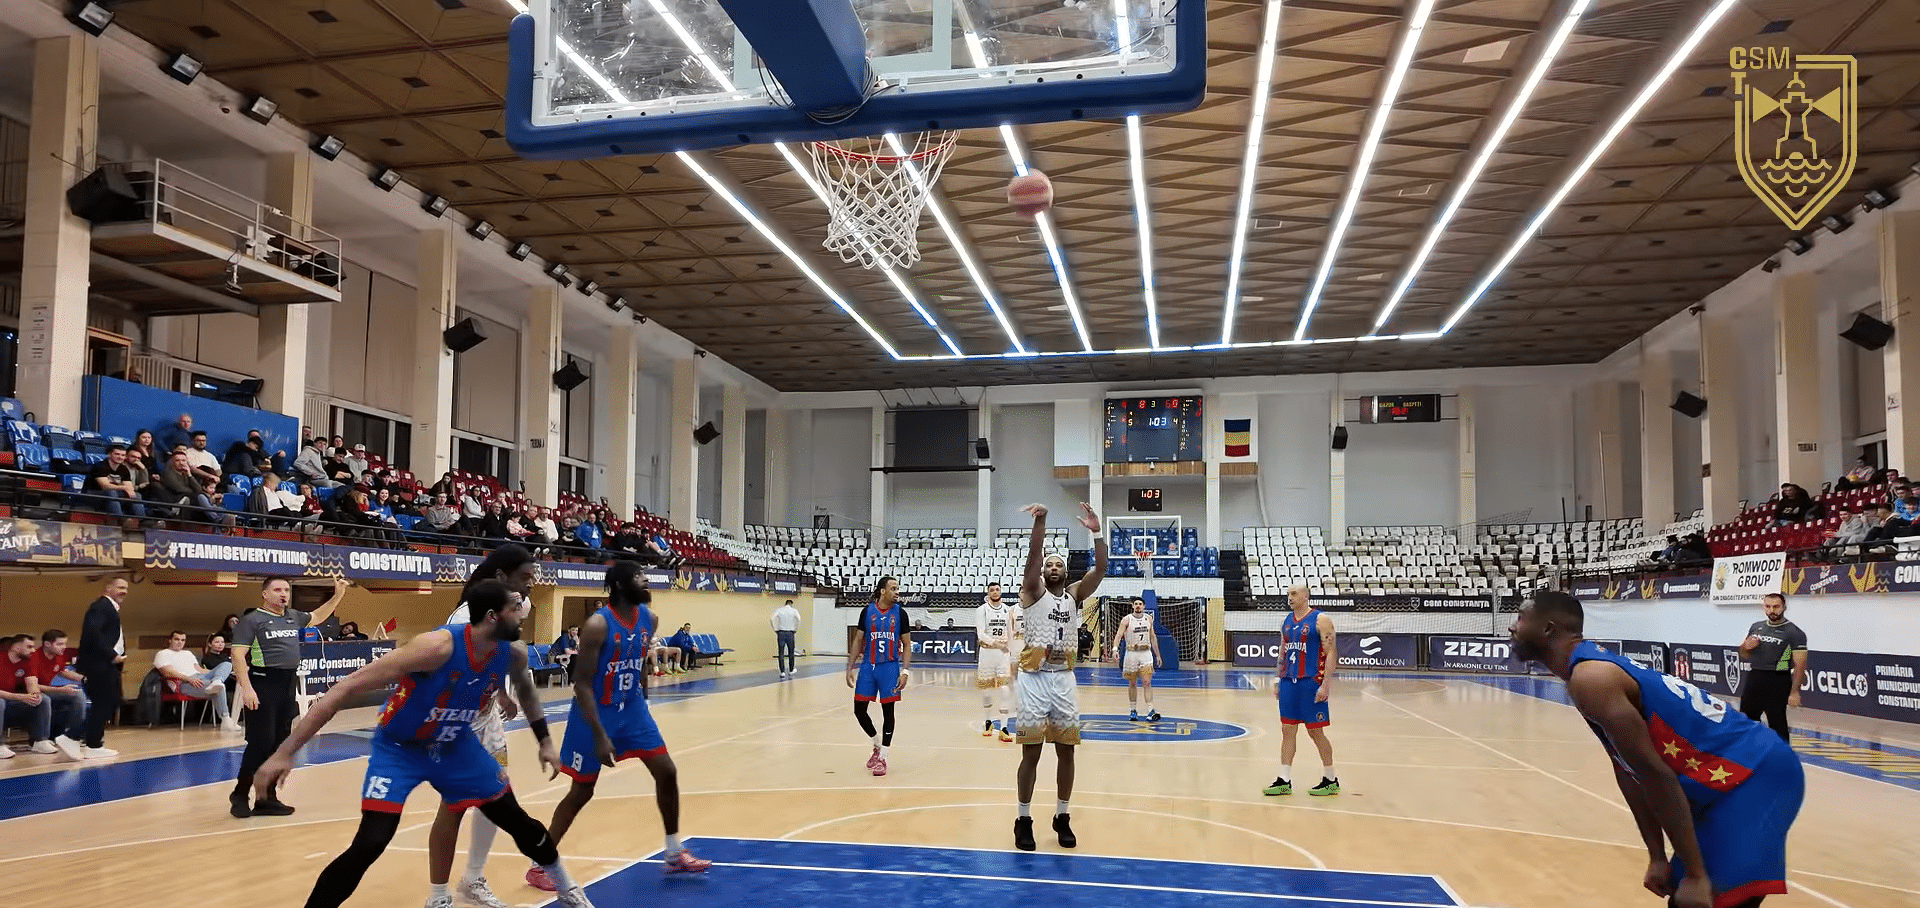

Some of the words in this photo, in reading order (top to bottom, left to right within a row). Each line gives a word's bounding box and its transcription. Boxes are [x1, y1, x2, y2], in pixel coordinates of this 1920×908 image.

[168, 541, 309, 567] #TEAMISEVERYTHING
[349, 551, 432, 576] CONSTANȚA
[1732, 559, 1782, 575] ROMWOOD
[1737, 574, 1771, 588] GROUP
[1894, 565, 1920, 584] CON
[1423, 599, 1442, 608] CSM
[1443, 600, 1490, 609] CONSTANȚA
[870, 631, 895, 642] STEAUA
[1057, 627, 1064, 640] 1
[1138, 633, 1144, 641] 7
[878, 640, 886, 653] 5
[922, 640, 976, 654] FRIAL
[1268, 645, 1279, 658] C
[319, 656, 367, 670] Constanța
[1289, 651, 1296, 664] 4
[604, 658, 644, 676] STEAU
[1875, 664, 1914, 678] PRIMĂRIA
[307, 675, 326, 684] mare
[618, 672, 634, 691] 13
[436, 725, 463, 742] 15
[365, 775, 393, 799] 15
